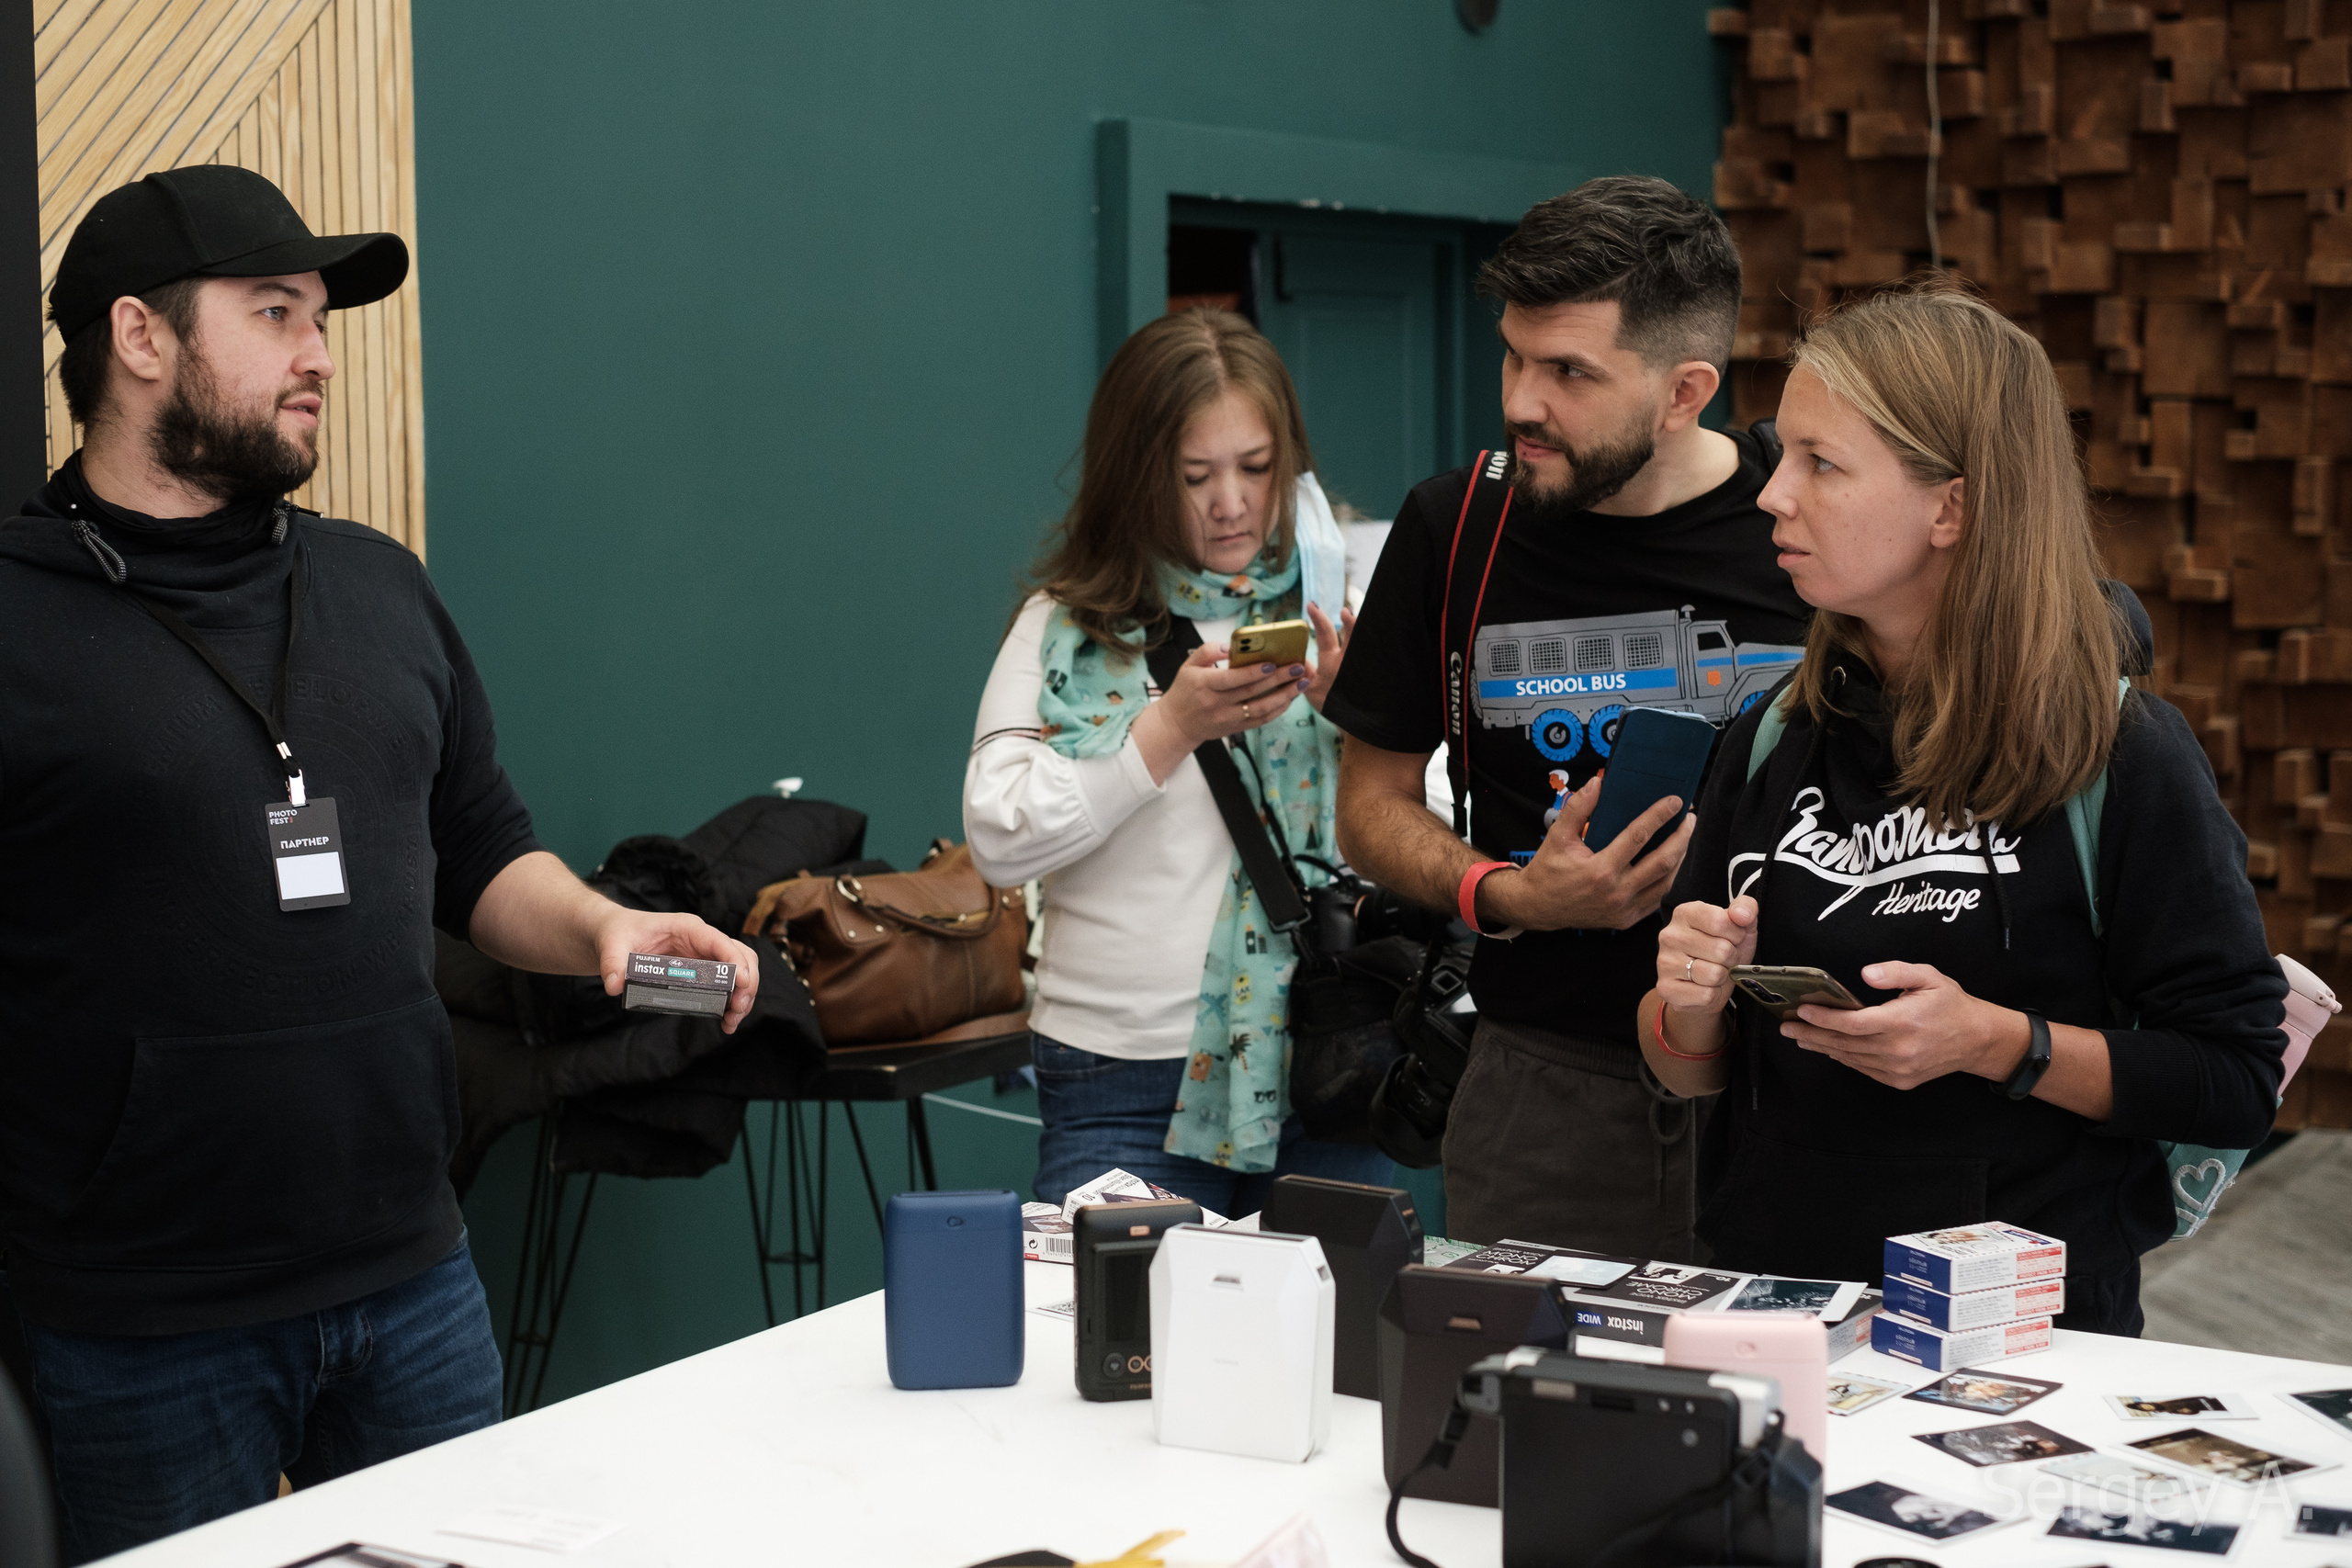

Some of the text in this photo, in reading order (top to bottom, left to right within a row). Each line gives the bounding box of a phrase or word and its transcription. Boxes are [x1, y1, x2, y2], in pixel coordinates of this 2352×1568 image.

[1516, 673, 1626, 696] SCHOOL BUS
[1450, 651, 1463, 736] Canon
[268, 809, 298, 818] PHOTO
[269, 817, 289, 825] FEST
[280, 836, 329, 850] ПАРТНЕР
[1871, 880, 1981, 923] Heritage
[634, 962, 729, 977] instax SQUARE 10
[1483, 1250, 1538, 1260] MONO
[1625, 1280, 1703, 1296] CHROME
[1637, 1287, 1697, 1300] MONO
[1577, 1313, 1644, 1336] instax WIDE
